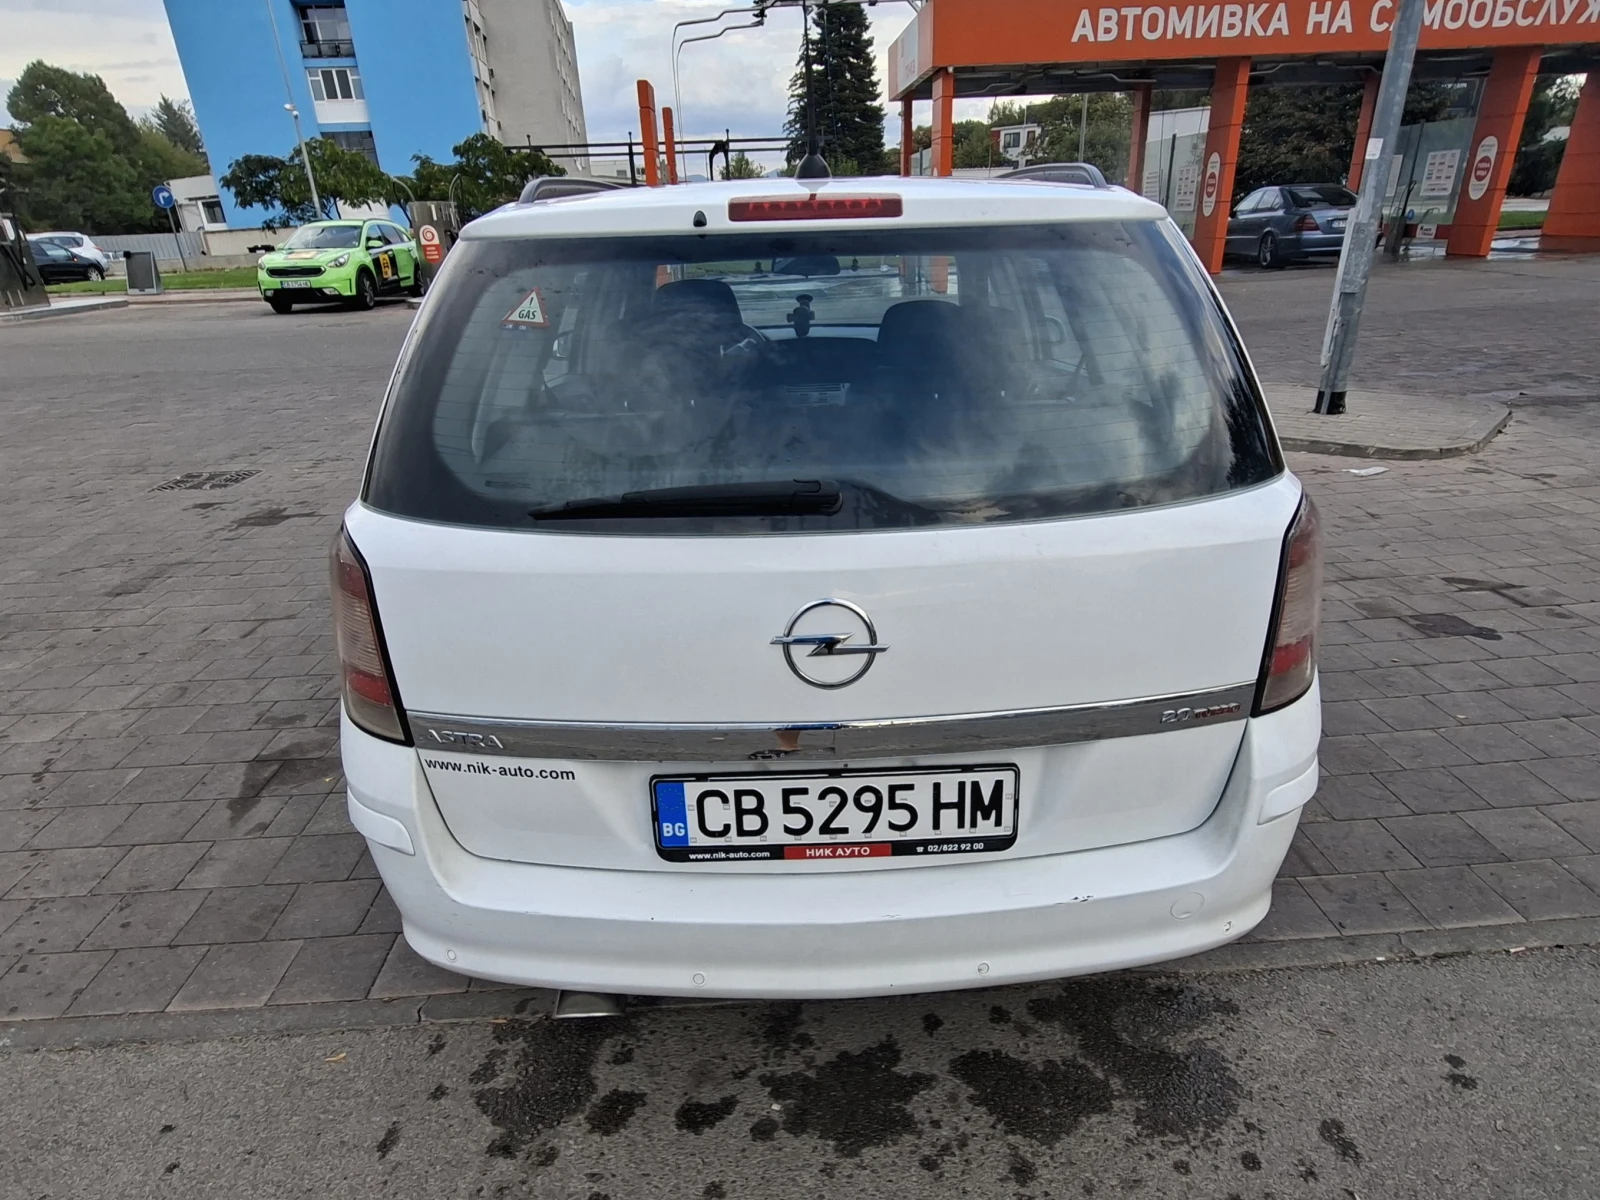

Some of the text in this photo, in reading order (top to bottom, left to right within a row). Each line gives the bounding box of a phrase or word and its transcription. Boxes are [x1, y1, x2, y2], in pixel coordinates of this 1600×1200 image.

[1071, 0, 1600, 43] АВТОМИВКА НА СМООБСЛУ
[518, 309, 537, 320] GAS
[427, 729, 504, 749] ASTRA
[424, 758, 576, 781] www.nik-auto.com
[781, 784, 919, 837] 5295
[662, 822, 686, 837] BG
[689, 850, 771, 860] www.nik-auto.com
[806, 846, 871, 858] НИК АУТО
[927, 842, 984, 853] 02/822 92 00
